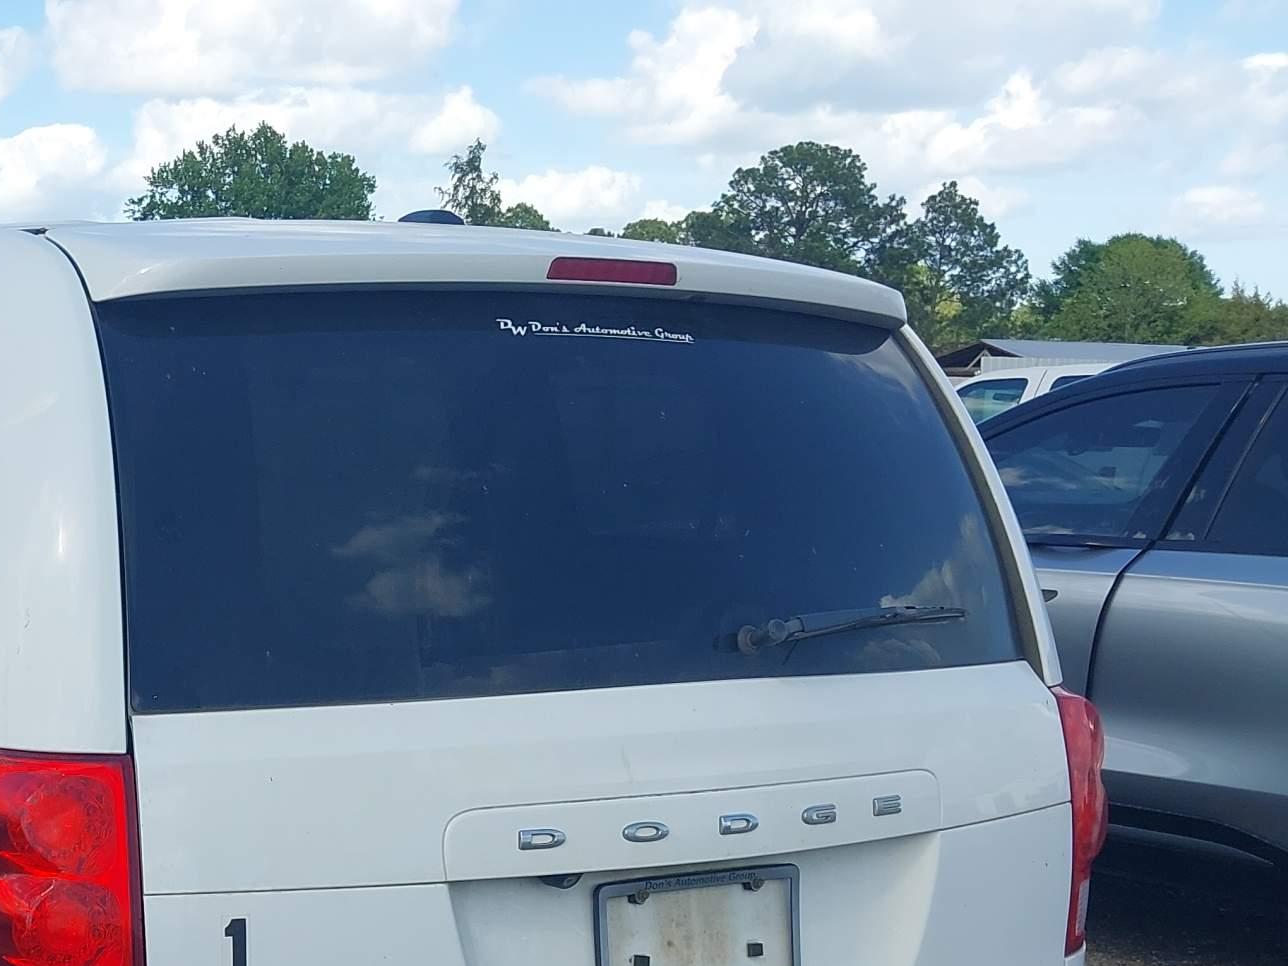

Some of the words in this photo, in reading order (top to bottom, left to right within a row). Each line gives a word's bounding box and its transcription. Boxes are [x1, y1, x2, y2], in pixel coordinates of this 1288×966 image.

[528, 321, 570, 334] Don's
[574, 323, 653, 338] Automotive
[655, 327, 695, 342] Group
[516, 793, 904, 851] DODGE
[643, 877, 673, 892] Don's
[674, 872, 727, 889] Automotive
[728, 870, 758, 883] Group
